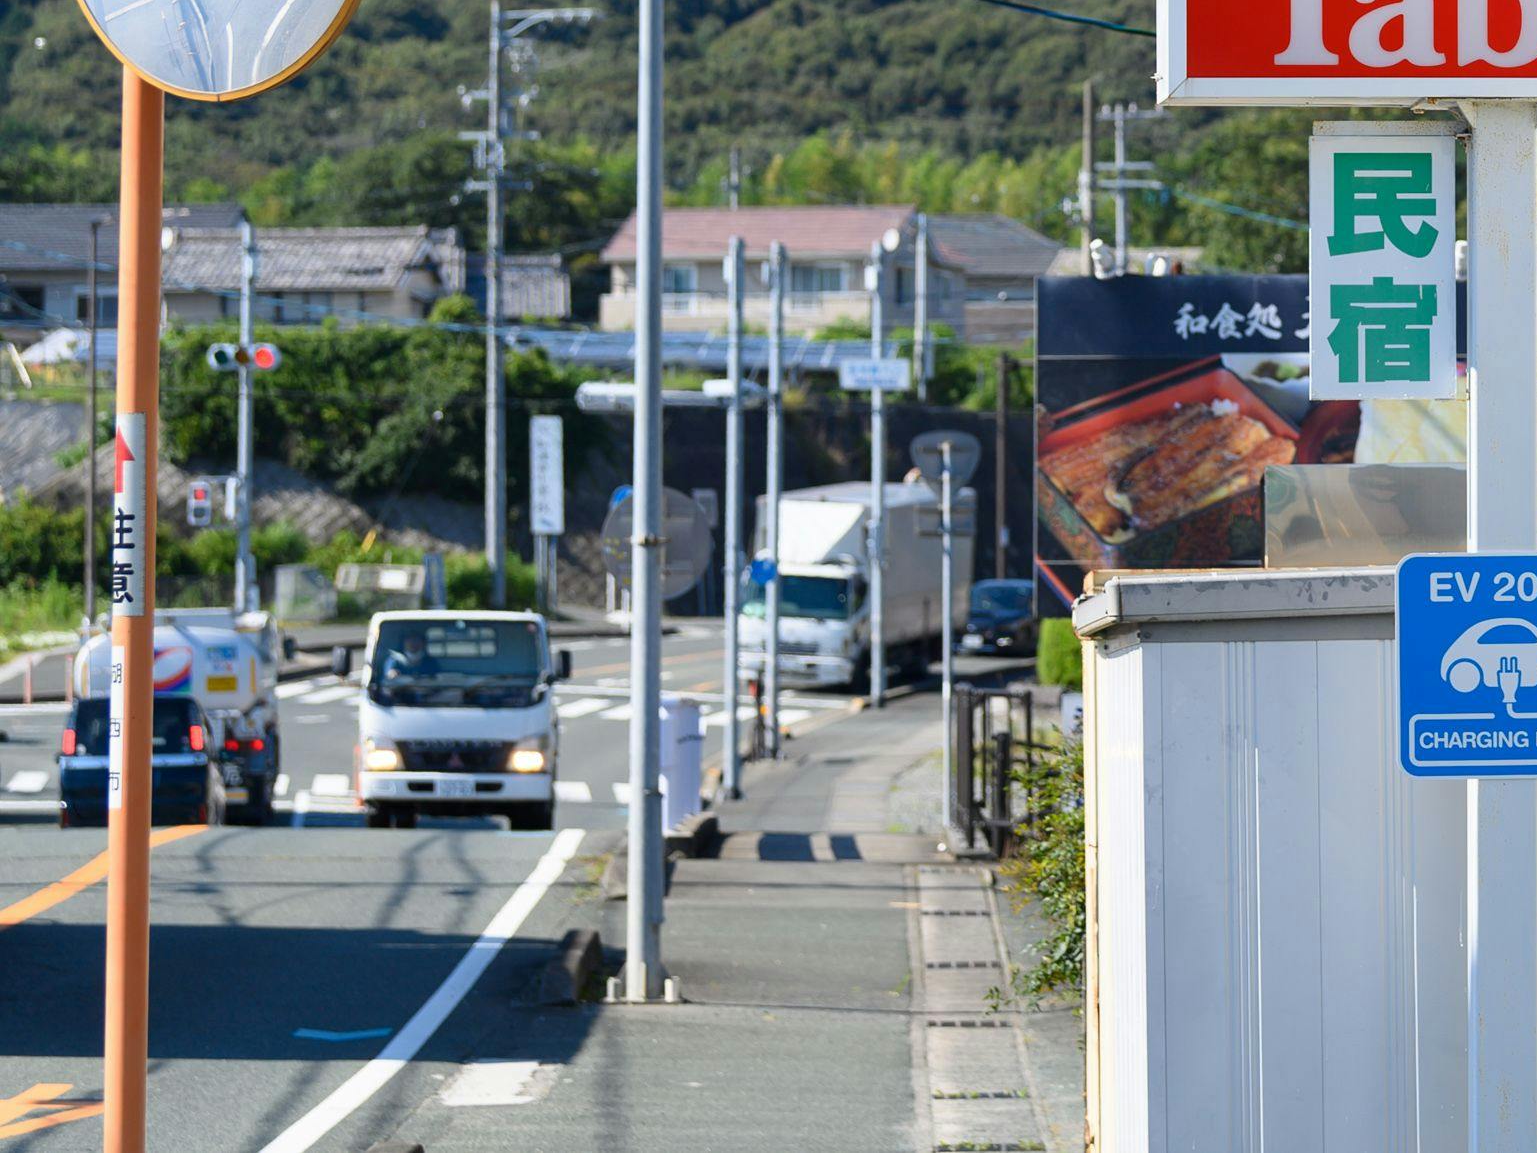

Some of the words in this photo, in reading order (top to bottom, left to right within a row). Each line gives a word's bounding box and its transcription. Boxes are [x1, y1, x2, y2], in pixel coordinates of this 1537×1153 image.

[1327, 153, 1438, 382] 民宿
[1173, 302, 1282, 340] 和食処
[1430, 571, 1480, 602] EV
[1419, 730, 1529, 750] CHARGING
